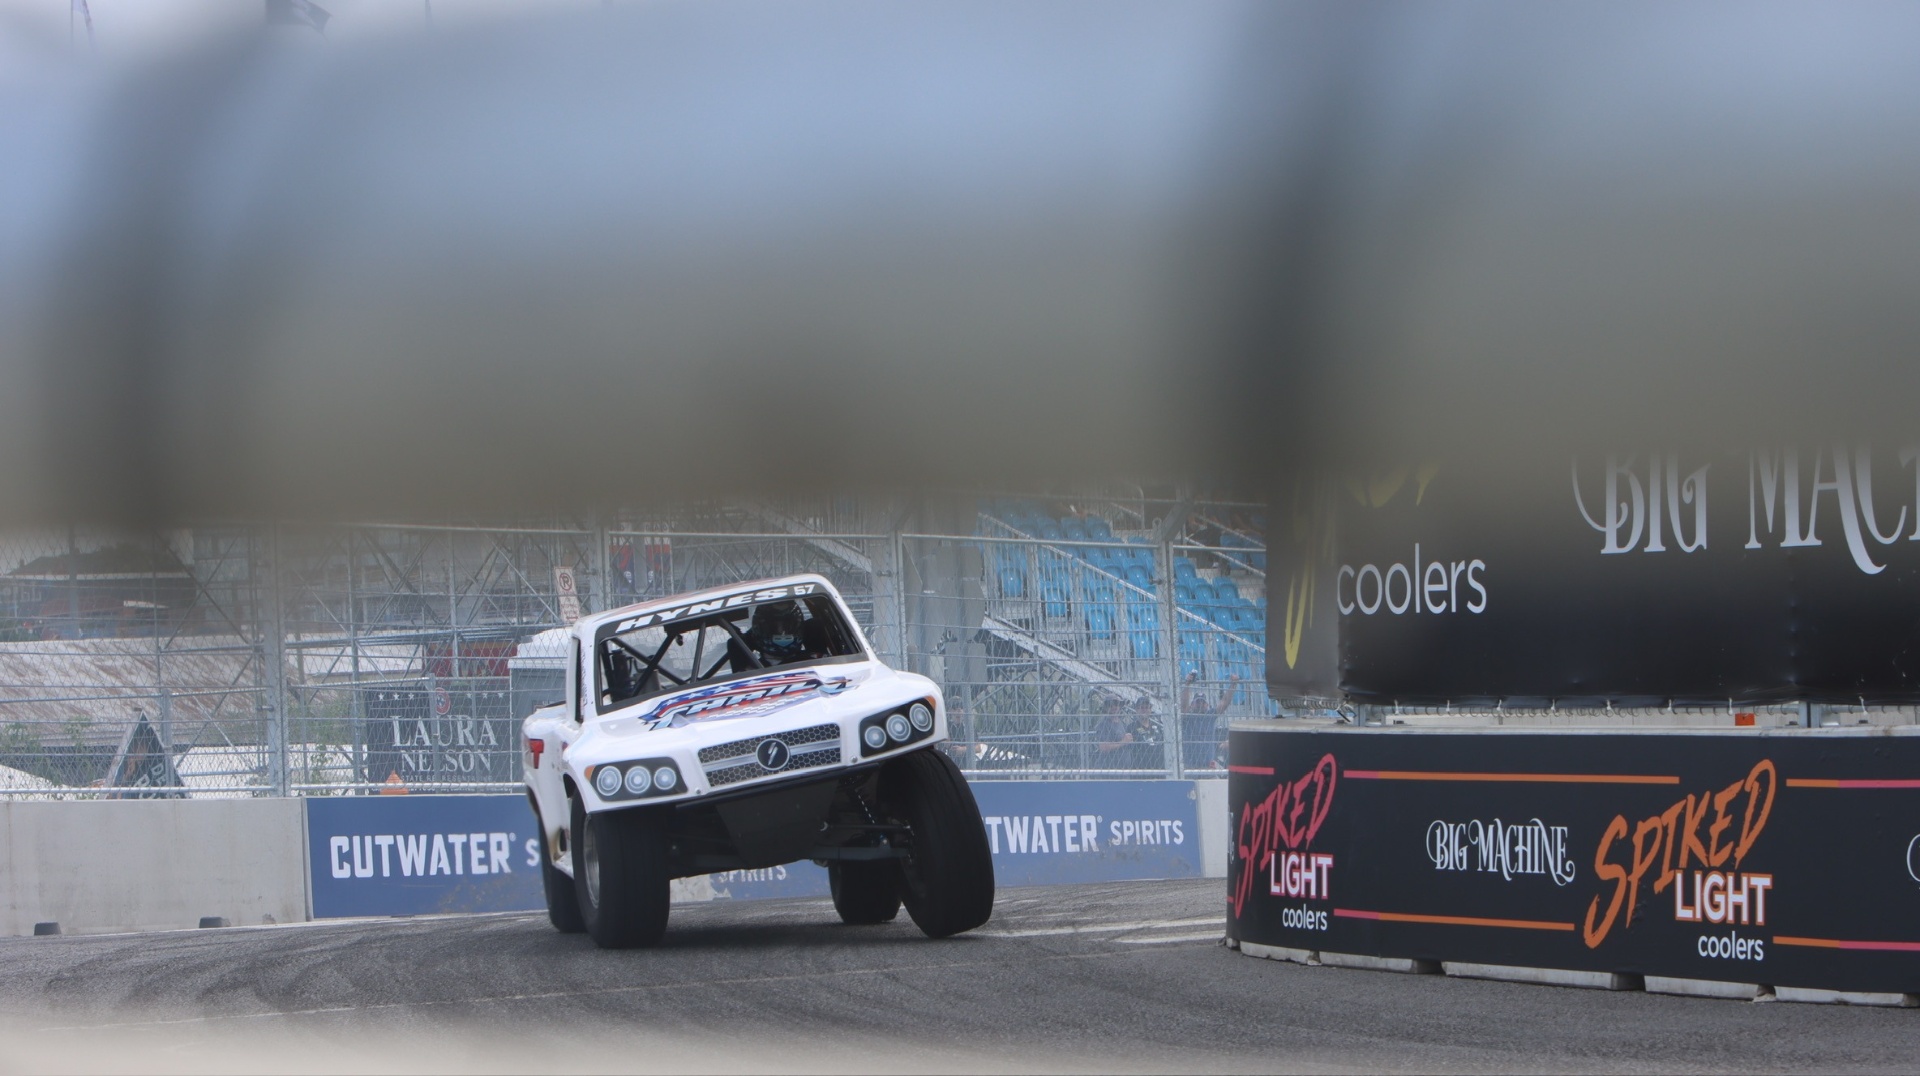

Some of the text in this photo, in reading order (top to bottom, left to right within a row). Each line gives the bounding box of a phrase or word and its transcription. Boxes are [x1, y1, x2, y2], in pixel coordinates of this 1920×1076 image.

[1571, 445, 1920, 575] BIG MAC
[1337, 542, 1487, 615] coolers
[615, 588, 788, 633] HYNES
[390, 715, 498, 747] LAURA
[1110, 820, 1184, 846] SPIRITS
[1234, 753, 1337, 920] SPIKED
[1426, 818, 1576, 887] BIG MACHINE
[1583, 759, 1776, 949] SPIKED
[1270, 852, 1333, 899] LIGHT
[1675, 870, 1773, 926] LIGHT
[1282, 904, 1328, 931] coolers
[1698, 931, 1764, 961] coolers
